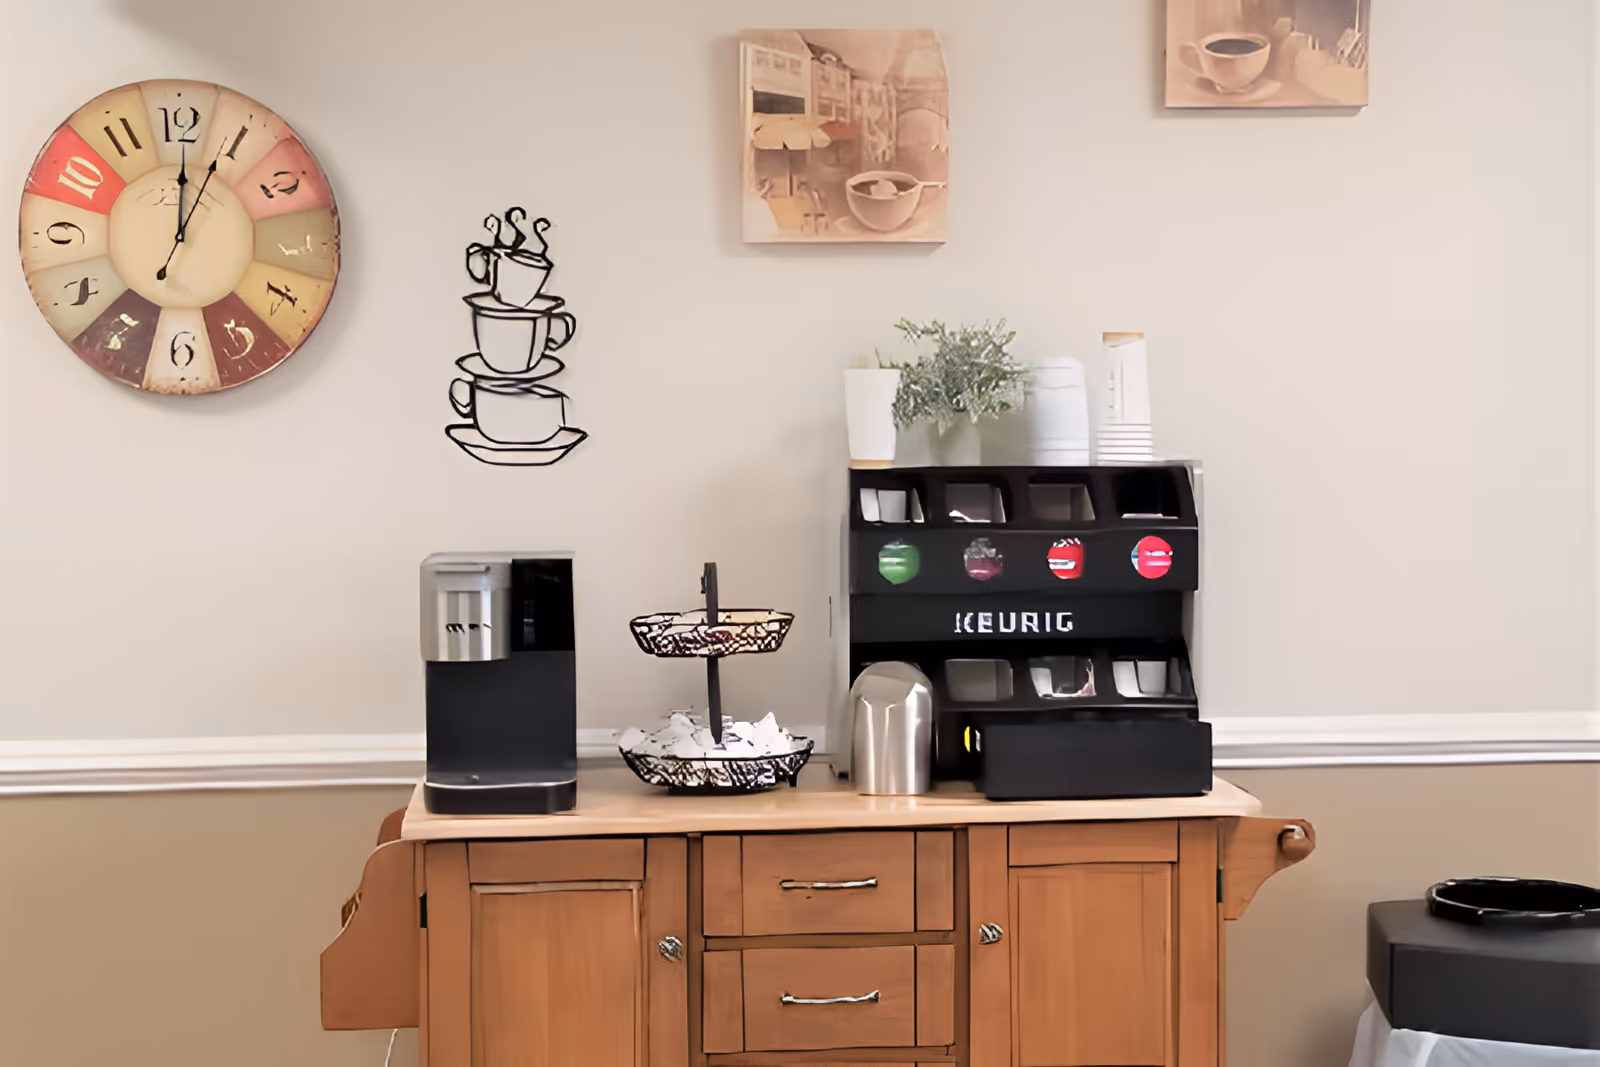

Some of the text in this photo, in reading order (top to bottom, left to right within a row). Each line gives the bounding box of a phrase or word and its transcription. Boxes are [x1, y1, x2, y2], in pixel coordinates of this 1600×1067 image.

[103, 117, 142, 157] 11
[157, 106, 201, 144] 12
[222, 125, 248, 161] 1
[57, 156, 105, 200] 10
[46, 221, 85, 246] 9
[170, 331, 195, 370] 6
[954, 612, 1074, 634] KEURIG
